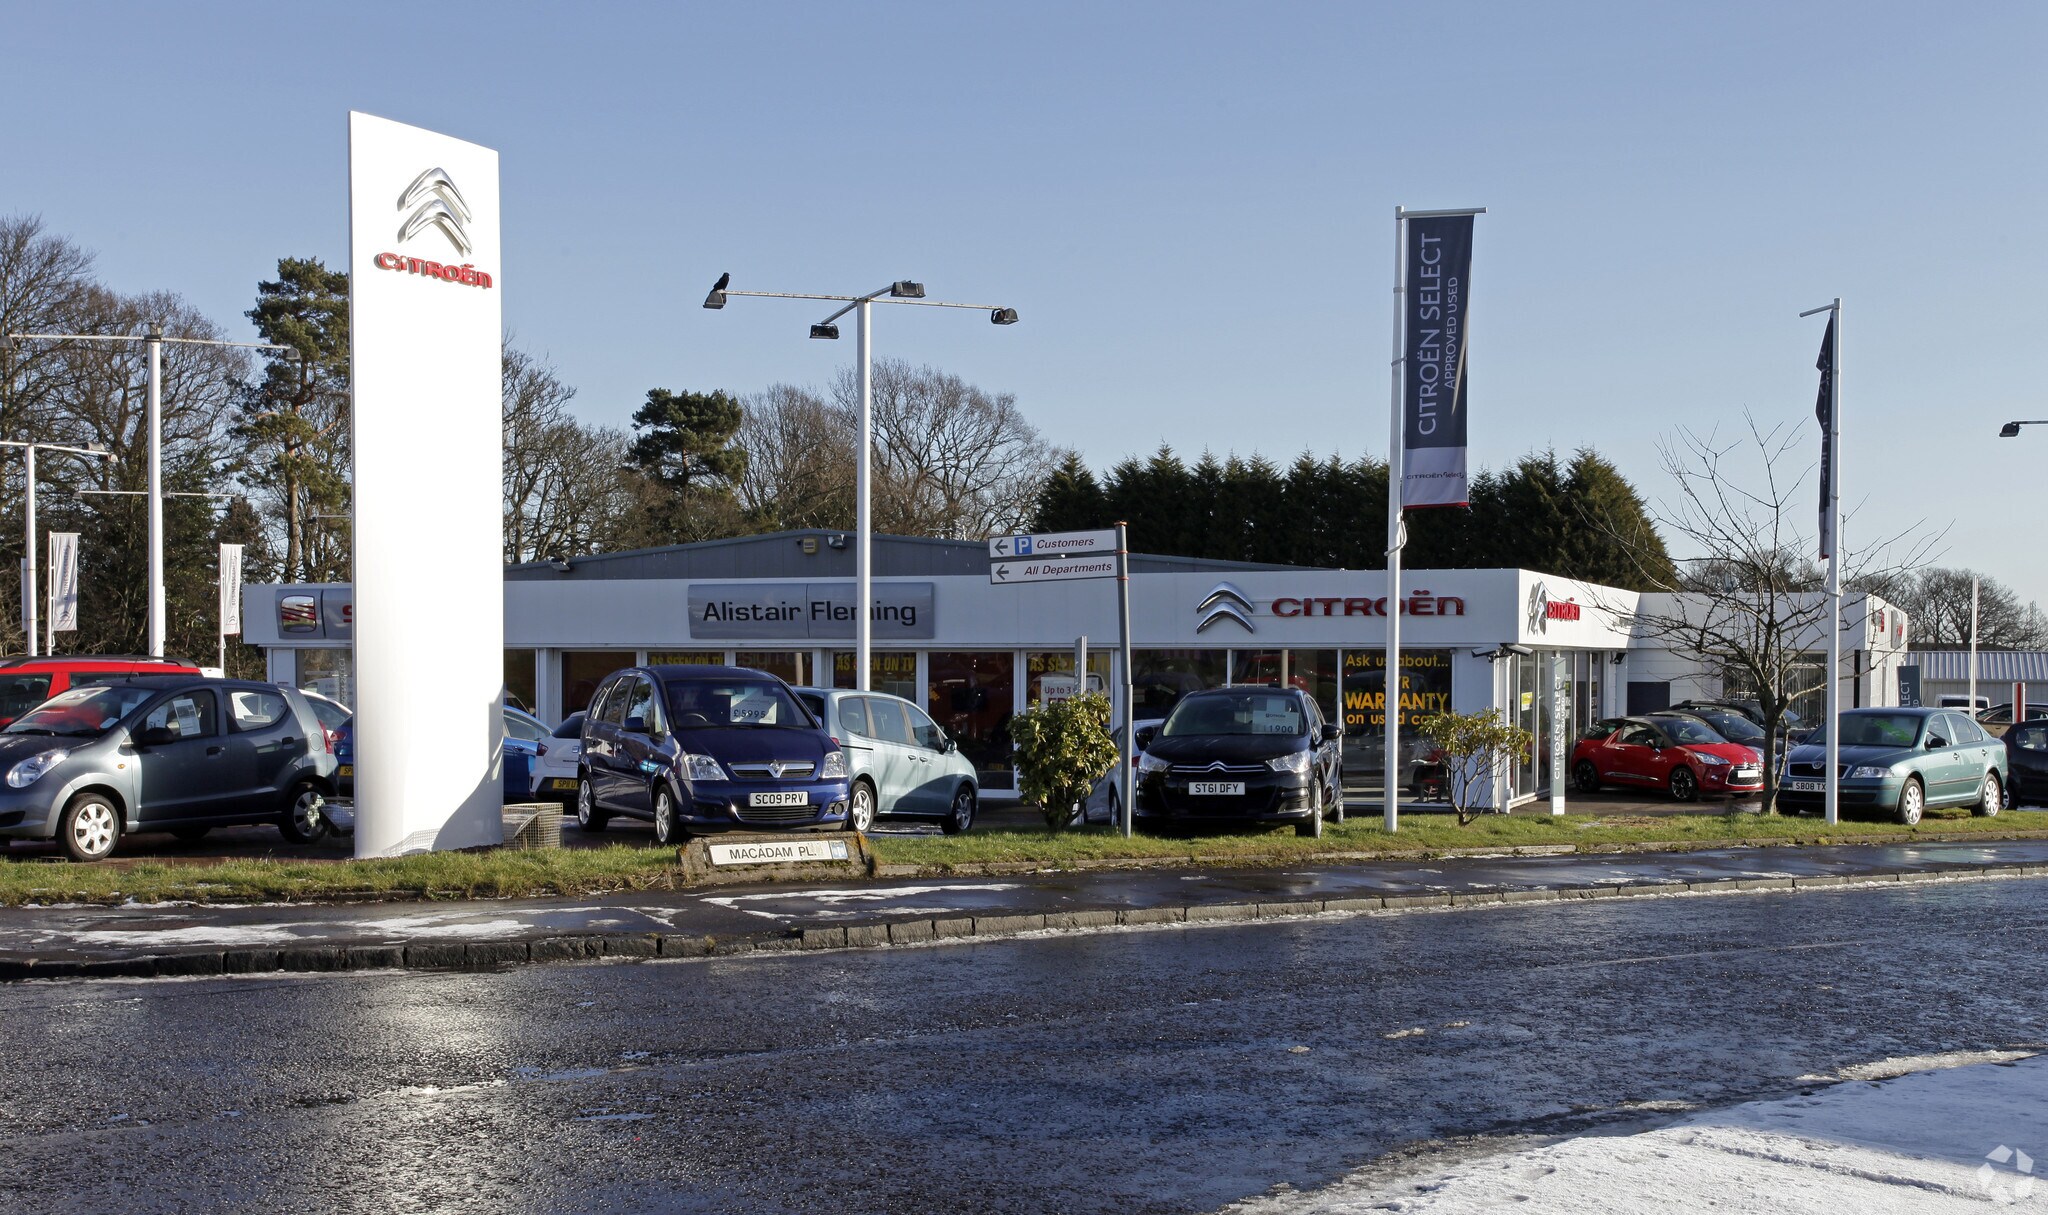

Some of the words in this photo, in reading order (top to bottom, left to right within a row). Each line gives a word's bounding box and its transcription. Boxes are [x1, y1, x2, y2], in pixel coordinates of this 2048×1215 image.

[376, 252, 492, 288] CITROËN
[1420, 233, 1441, 320] SELECT
[1446, 276, 1458, 314] USED
[1444, 316, 1458, 389] APPROVED
[1417, 329, 1441, 435] CITROËN
[1036, 538, 1095, 549] Customers
[1024, 566, 1039, 576] All
[1042, 563, 1112, 576] Departments
[1271, 589, 1465, 617] CITROËN
[702, 601, 801, 621] Alistair
[836, 655, 851, 671] AS
[884, 656, 900, 671] ON
[903, 656, 916, 671] TV
[1030, 656, 1045, 671] AS
[1345, 654, 1371, 667] Ask
[1044, 686, 1054, 695] Up
[1057, 686, 1065, 694] to
[1066, 686, 1071, 694] 3
[1345, 691, 1448, 710] WARANTY
[1346, 713, 1364, 725] on
[1370, 711, 1406, 725] usd
[1195, 783, 1217, 793] ST61
[1219, 783, 1239, 793] DFY
[755, 794, 782, 805] SC09
[784, 793, 804, 804] PRV
[729, 846, 793, 860] MACADAM
